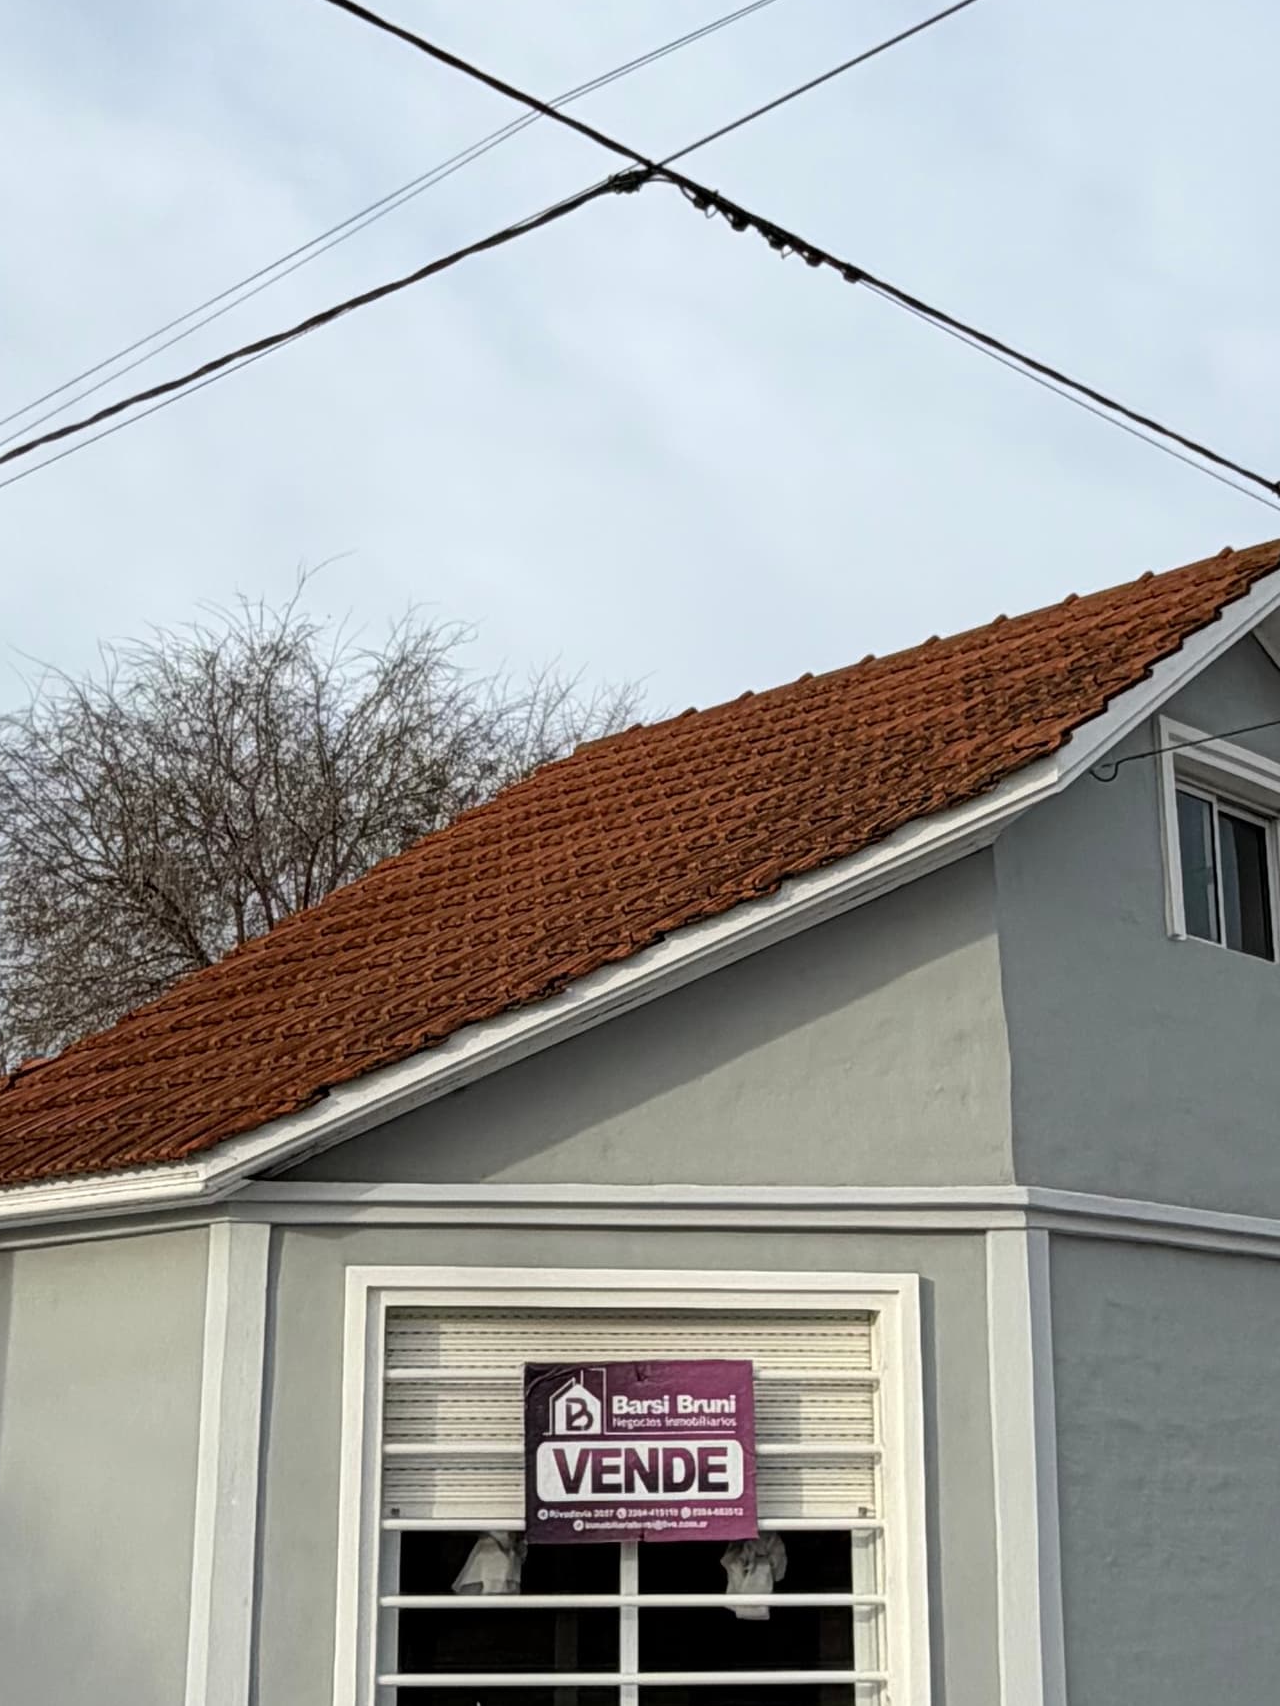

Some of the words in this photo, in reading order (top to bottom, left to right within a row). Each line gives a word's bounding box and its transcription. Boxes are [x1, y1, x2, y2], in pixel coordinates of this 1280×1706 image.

[612, 1395, 670, 1415] Barsi
[677, 1394, 737, 1414] Bruni
[552, 1447, 729, 1494] VENDE
